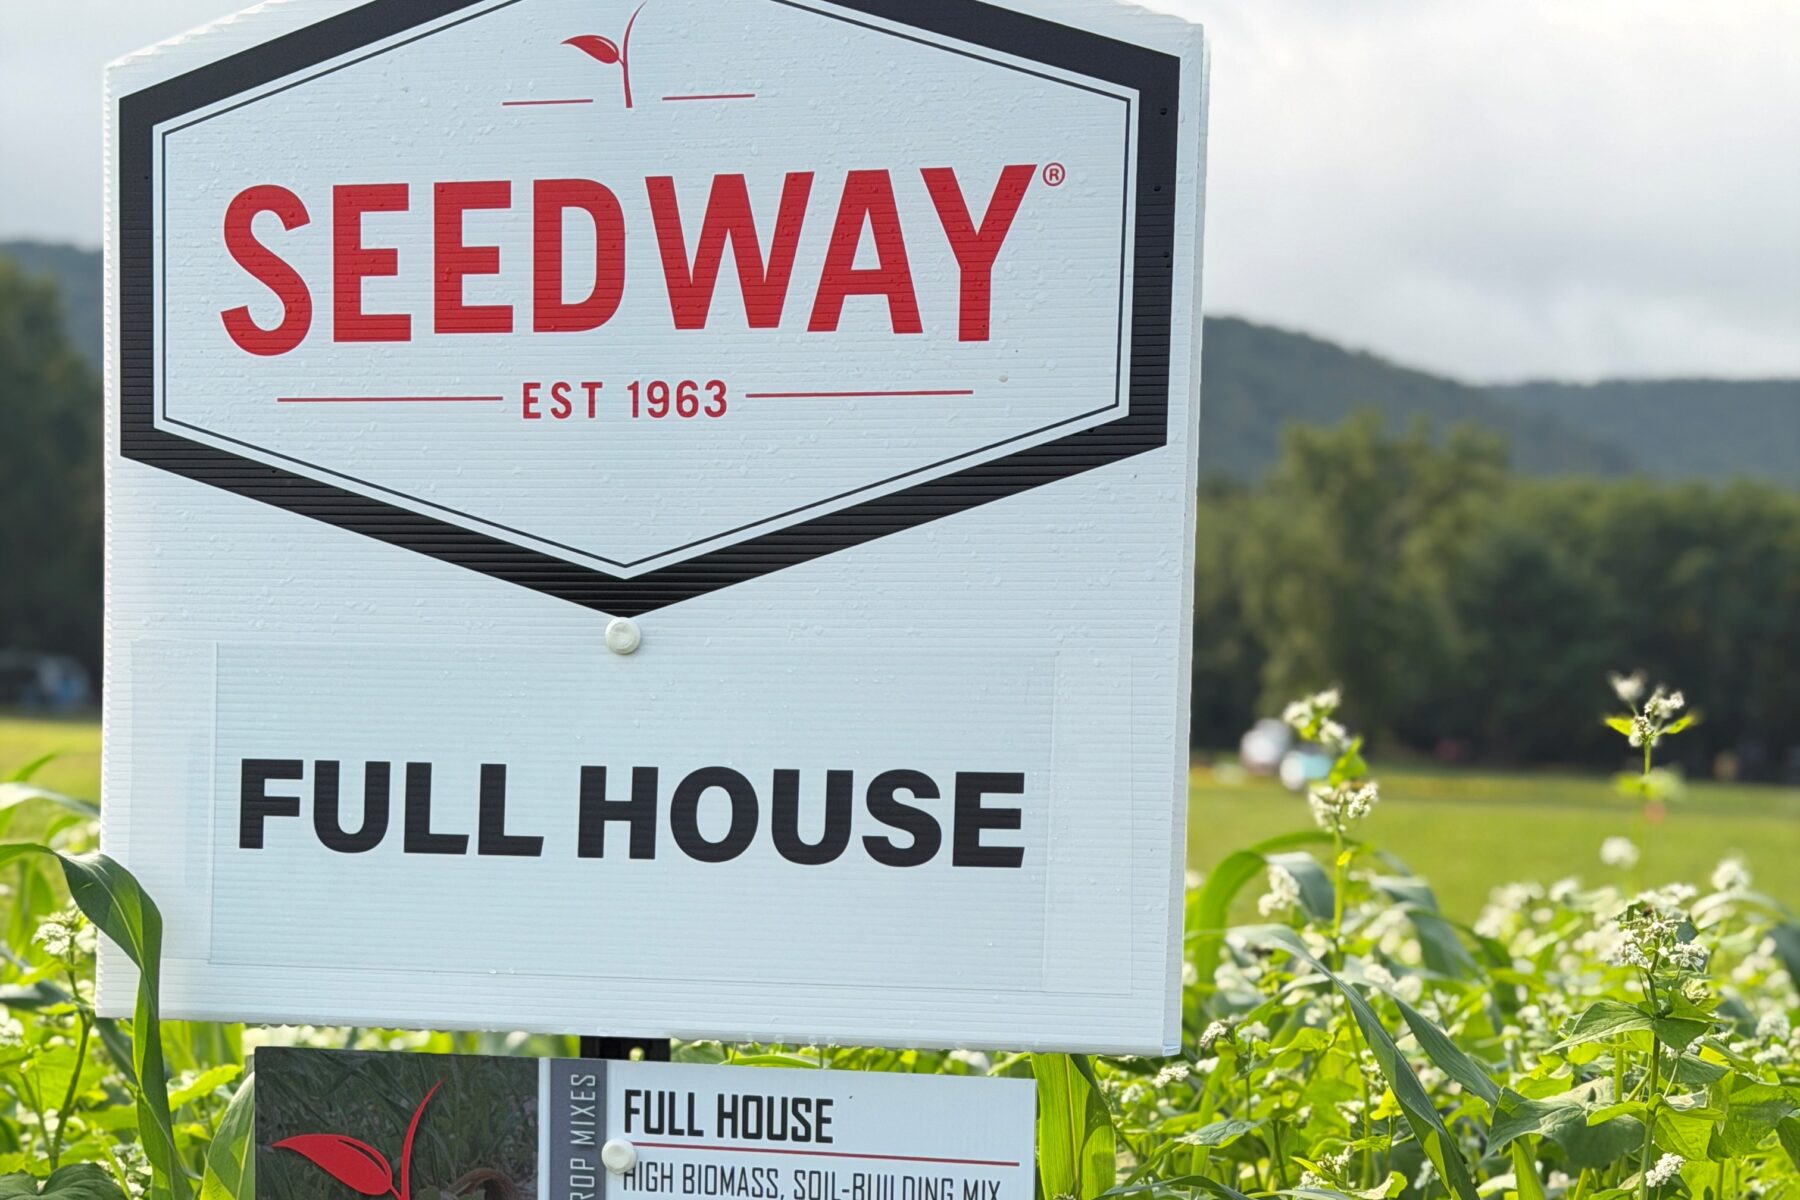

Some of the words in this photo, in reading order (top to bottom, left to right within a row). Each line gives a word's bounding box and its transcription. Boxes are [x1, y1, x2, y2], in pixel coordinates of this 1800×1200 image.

[522, 381, 603, 419] EST
[627, 380, 727, 419] 1963
[239, 758, 544, 857] FULL
[577, 766, 1025, 867] HOUSE
[570, 1074, 596, 1146] MIXES
[624, 1089, 704, 1137] FULL
[716, 1093, 833, 1144] HOUSE
[623, 1160, 674, 1193] HIGH
[682, 1163, 784, 1200] BIOMASS,
